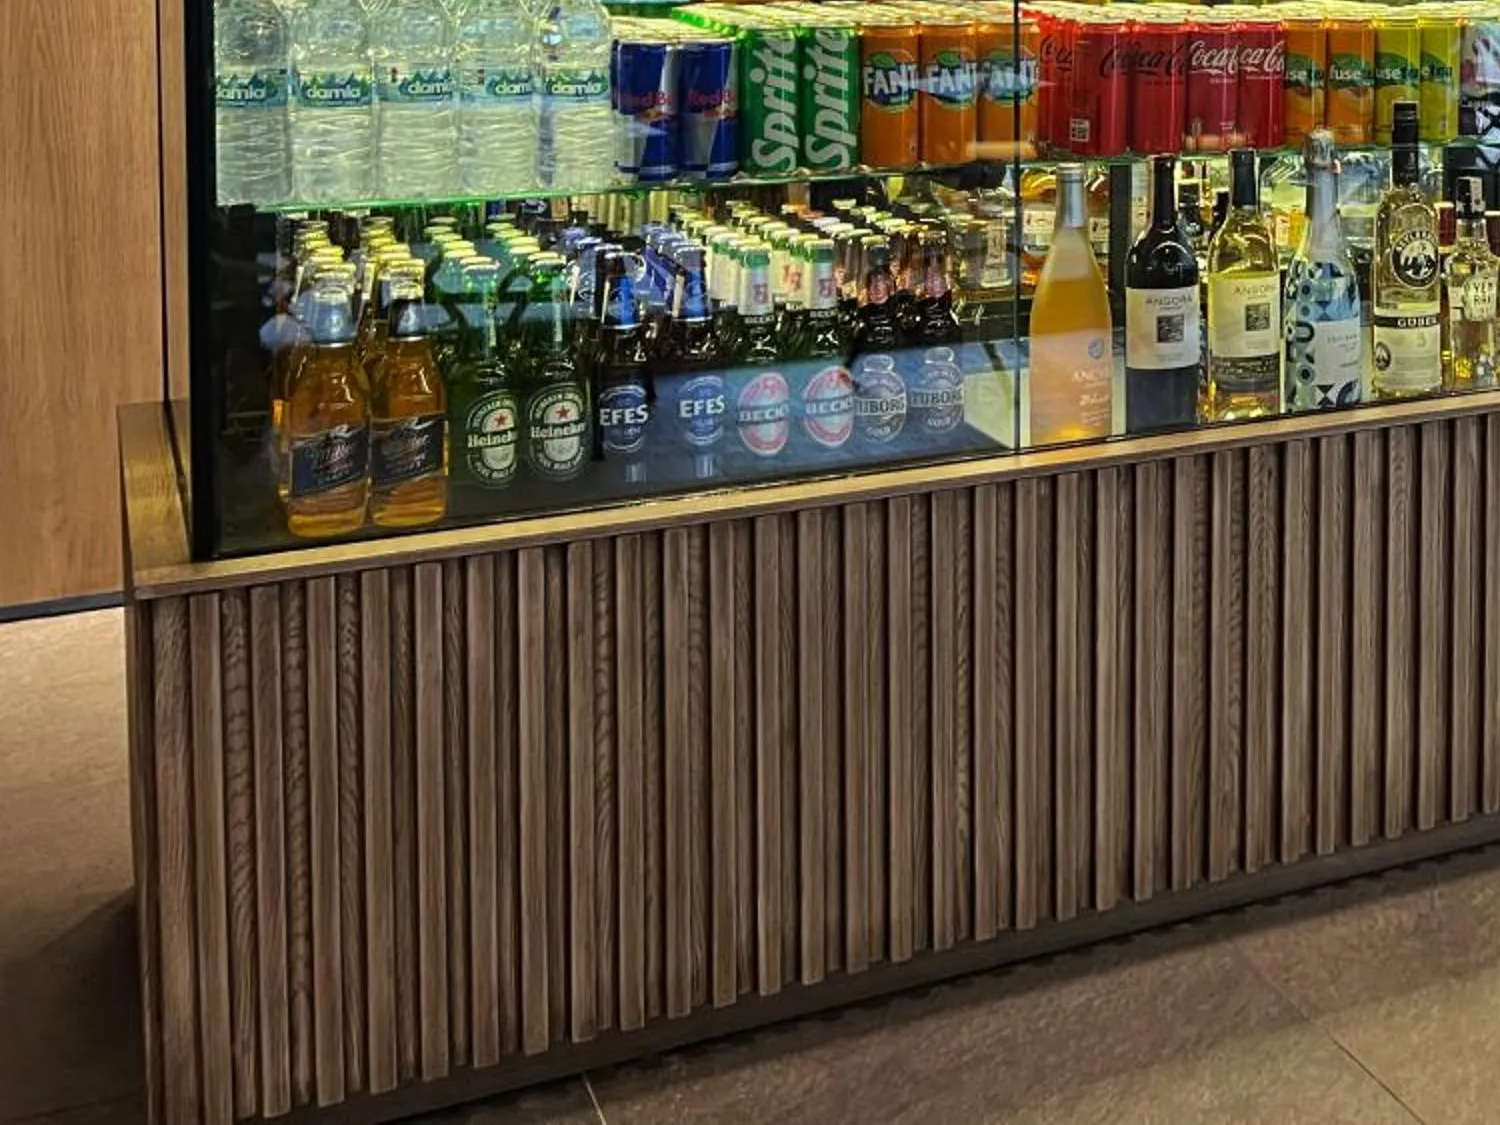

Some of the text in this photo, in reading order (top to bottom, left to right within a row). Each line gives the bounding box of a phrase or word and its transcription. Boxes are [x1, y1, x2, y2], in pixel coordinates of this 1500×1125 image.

[306, 82, 361, 99] damla
[552, 80, 601, 96] damla
[863, 63, 919, 95] FANT
[926, 62, 977, 94] FANT
[750, 28, 799, 173] Sprite
[803, 27, 857, 171] Sprite
[599, 404, 649, 426] EFES
[679, 394, 725, 418] EFES
